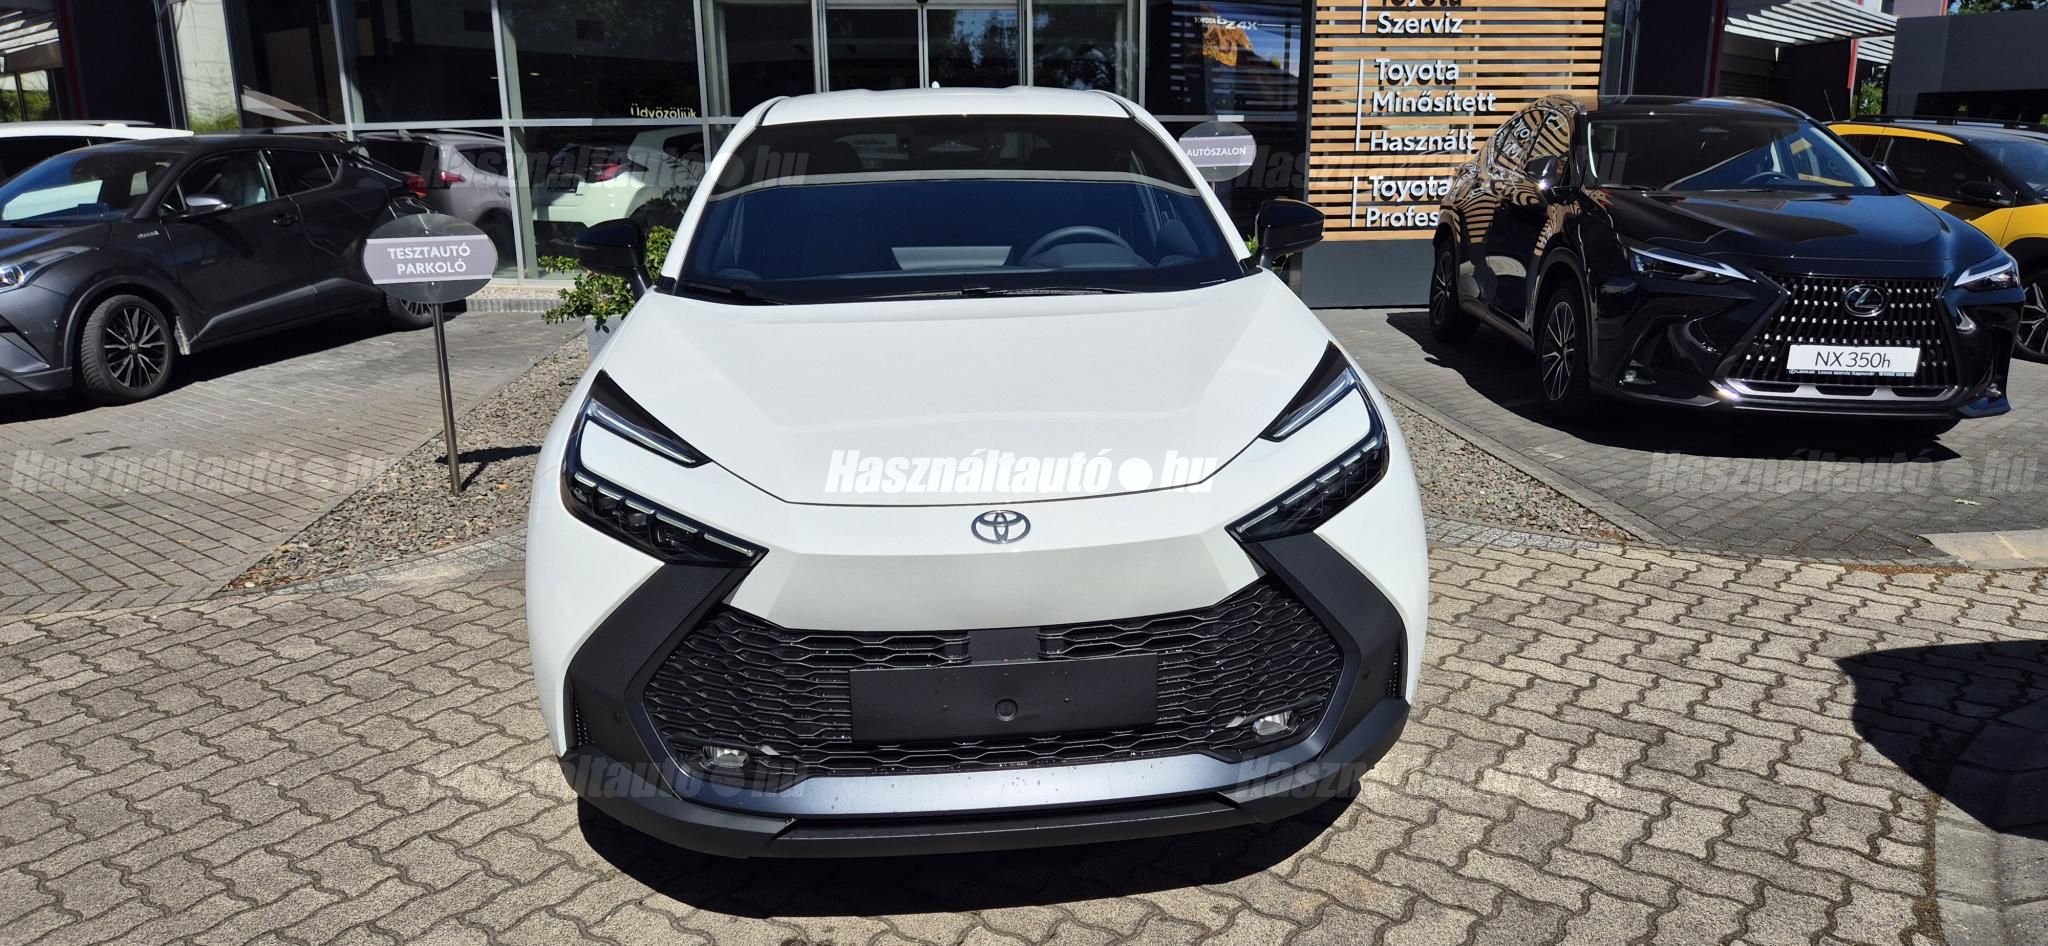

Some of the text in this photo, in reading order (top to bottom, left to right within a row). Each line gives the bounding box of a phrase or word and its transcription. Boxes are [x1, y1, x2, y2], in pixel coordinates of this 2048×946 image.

[1377, 11, 1464, 34] Szerviz
[1375, 57, 1460, 87] Toyota
[1372, 90, 1497, 113] Minősített
[1370, 128, 1476, 151] Használt
[1186, 145, 1247, 158] AUTÓSZALON
[1368, 175, 1452, 203] Toyota
[1366, 205, 1440, 228] Profes
[387, 242, 471, 260] TESZTAUTÓ
[396, 258, 467, 275] PARKOLÓ
[1815, 351, 1891, 369] NX 350h
